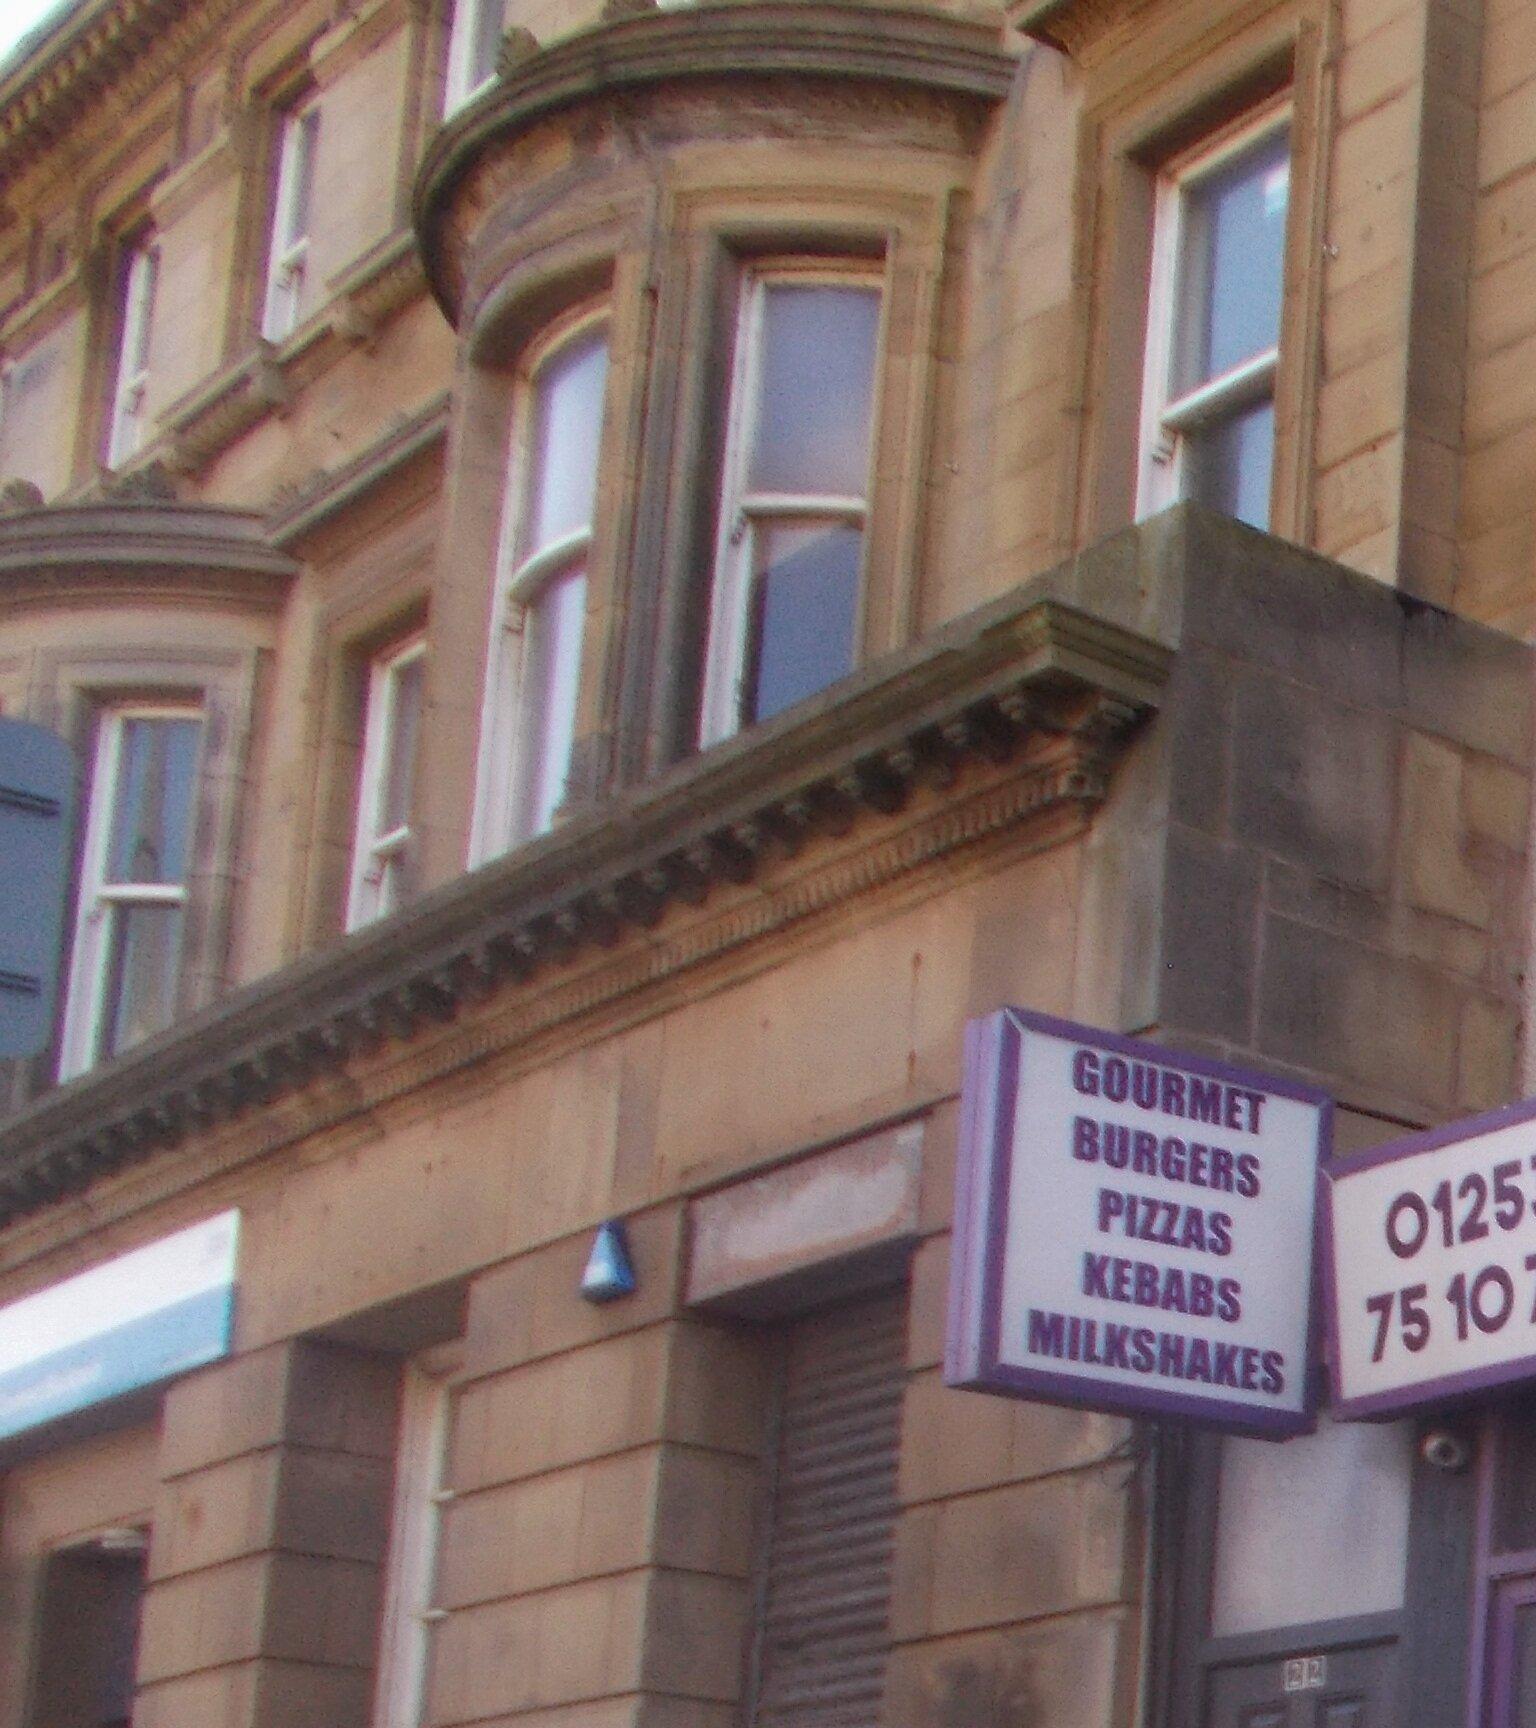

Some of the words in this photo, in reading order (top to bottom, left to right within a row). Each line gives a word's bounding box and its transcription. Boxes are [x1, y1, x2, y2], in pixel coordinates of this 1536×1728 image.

[1072, 1049, 1266, 1135] GOURMET
[1072, 1115, 1260, 1199] BURGERS
[1099, 1187, 1234, 1257] PIZZAS
[1082, 1251, 1242, 1324] KEBABS
[1028, 1308, 1286, 1395] MILKSHAKES
